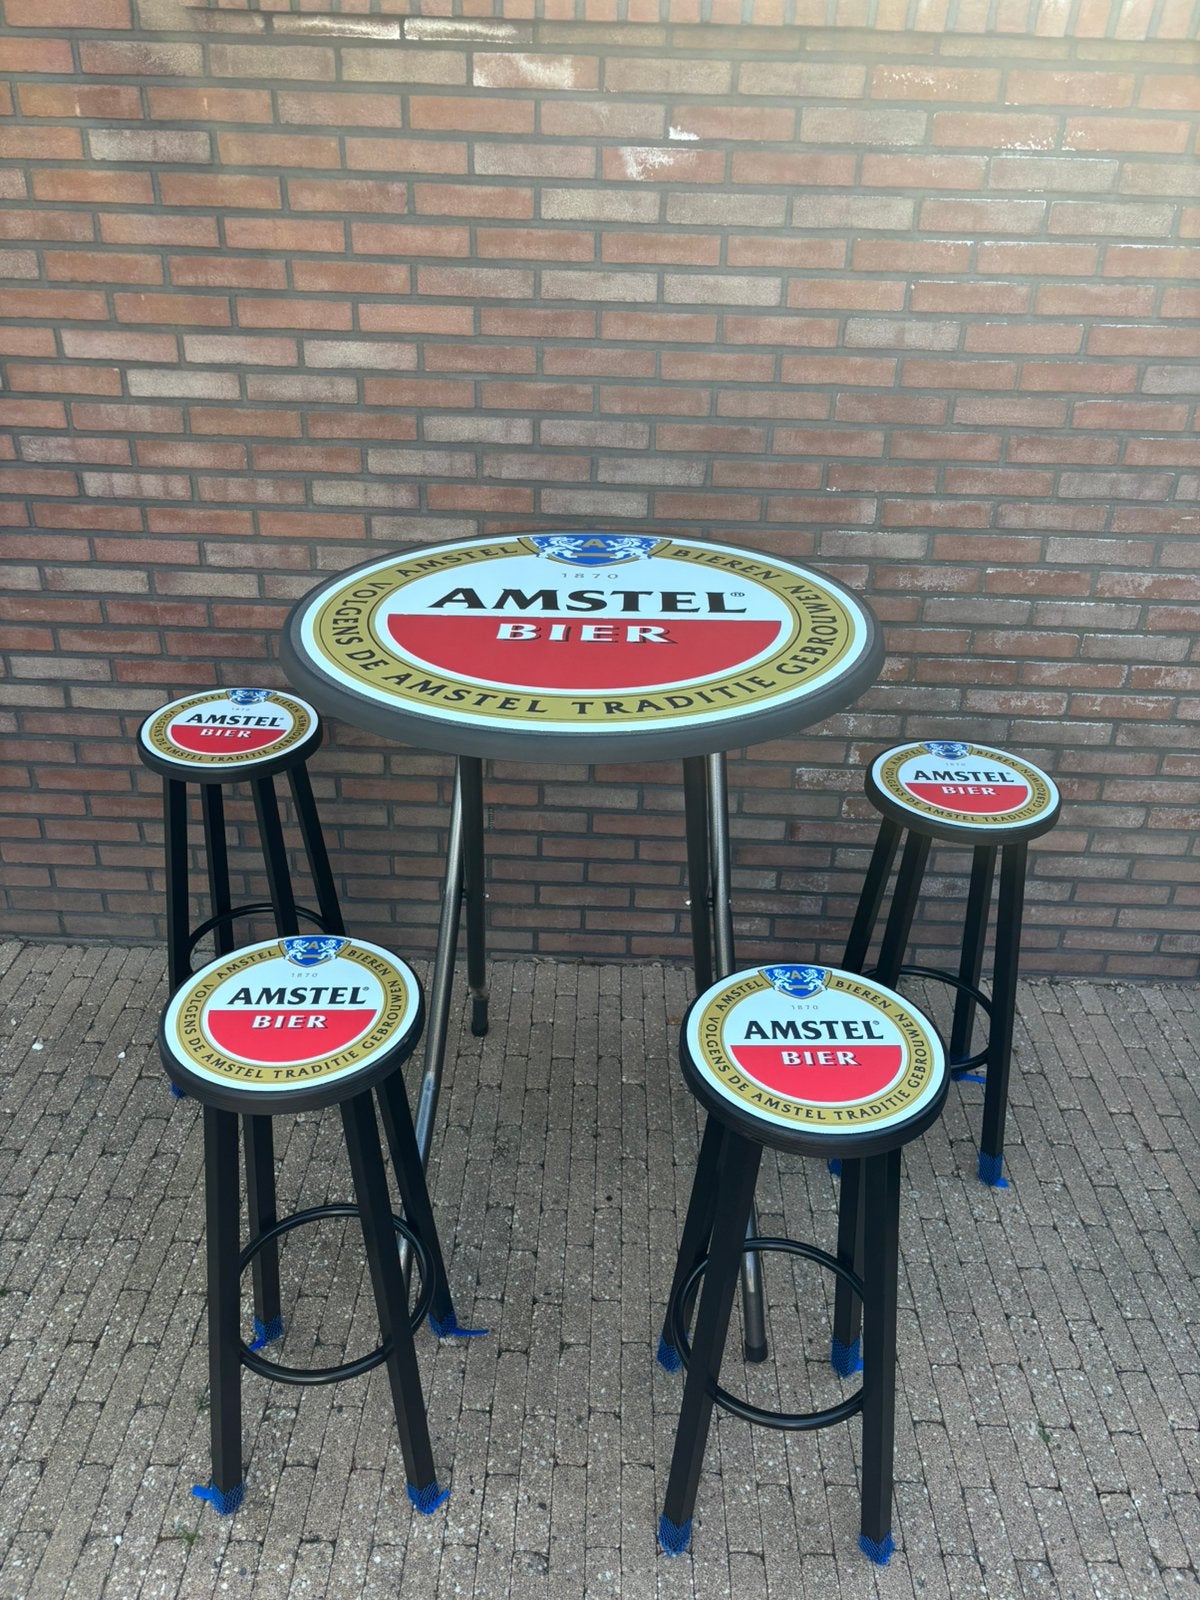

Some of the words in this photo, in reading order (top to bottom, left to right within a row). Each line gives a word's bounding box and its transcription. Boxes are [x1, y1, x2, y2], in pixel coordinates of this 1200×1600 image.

[397, 545, 519, 577] AMSTEL
[671, 548, 782, 581] BIEREN
[561, 572, 619, 580] 1870
[332, 582, 394, 646] VOLGENS
[495, 623, 678, 644] BIER
[776, 584, 838, 676] GEBROUWEN
[345, 649, 389, 671] DE
[180, 694, 224, 709] AMSTEL
[381, 672, 549, 714] AMSTEL
[570, 675, 777, 715] TRADITIE
[200, 728, 252, 739] BIER
[164, 746, 204, 761] AMSTEL
[891, 748, 925, 766] AMSTEL
[941, 785, 998, 796] BIER
[906, 797, 922, 807] DE
[924, 805, 978, 822] AMSTEL
[982, 806, 1036, 823] TRADITIE
[216, 949, 278, 980] AMSTEL
[347, 949, 392, 977] BIEREN
[715, 979, 764, 1012] AMSTEL
[835, 979, 892, 1010] BIEREN
[183, 983, 214, 1035] VOLGENS
[362, 979, 403, 1050] GEBROUWEN
[252, 1015, 329, 1030] BIER
[188, 1034, 206, 1053] DE
[201, 1053, 265, 1079] AMSTEL
[273, 1049, 360, 1079] TRADITIE
[704, 1016, 730, 1073] VOLGENS
[728, 1073, 750, 1092] DE
[750, 1091, 827, 1121] AMSTEL
[833, 1088, 911, 1121] TRADITIE
[894, 1011, 928, 1089] GEBROUWEN
[780, 1050, 862, 1067] BIER
